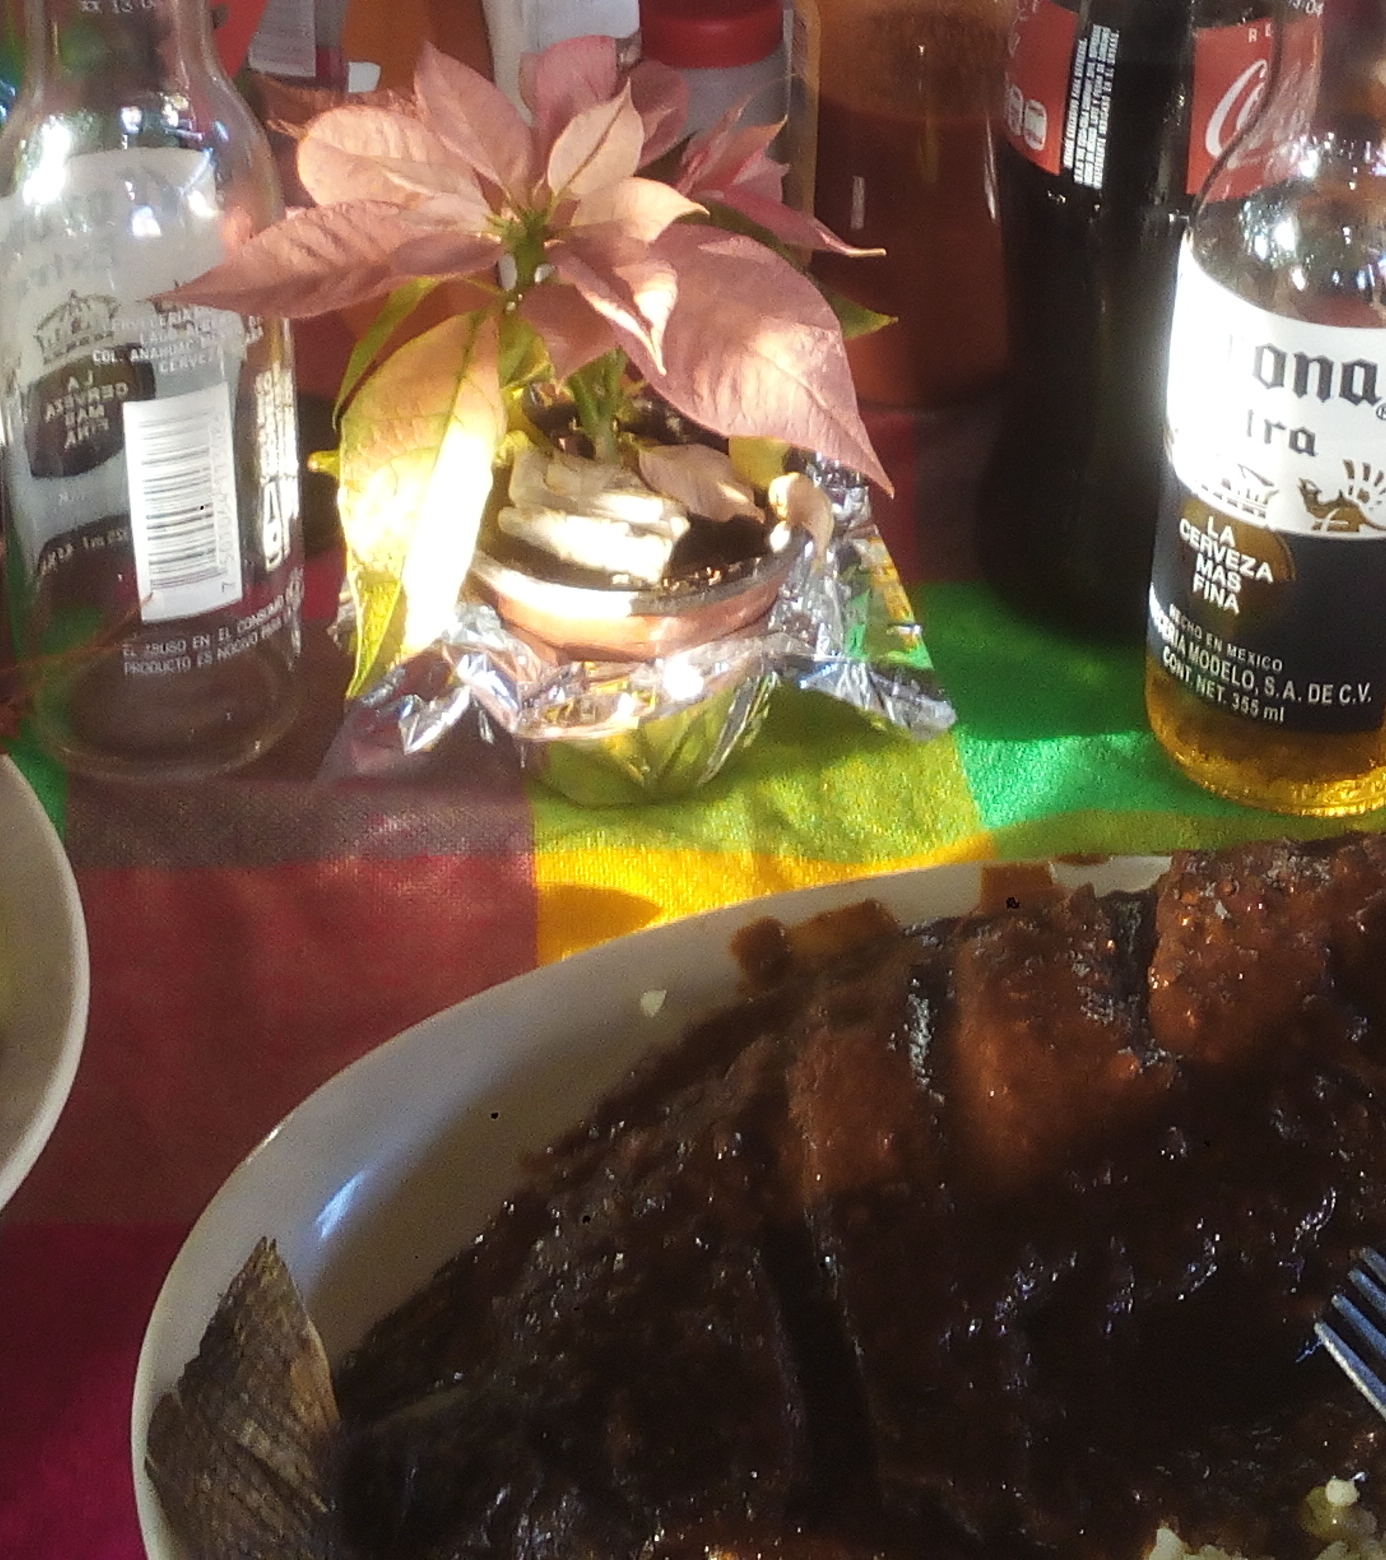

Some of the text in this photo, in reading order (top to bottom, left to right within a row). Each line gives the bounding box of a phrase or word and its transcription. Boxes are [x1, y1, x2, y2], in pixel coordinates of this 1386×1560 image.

[1251, 342, 1382, 407] ona
[1179, 517, 1274, 584] CERVEZA
[1207, 515, 1237, 549] LA
[1192, 572, 1241, 616] FINA
[1196, 551, 1242, 594] MAS
[192, 633, 211, 650] EN
[218, 626, 232, 641] EL
[1169, 603, 1284, 674] HECHO EN MEXICO
[123, 655, 192, 676] PRODUCTO
[1188, 641, 1260, 697] MODELO,
[1308, 682, 1334, 705] DE
[1231, 691, 1260, 718] 355
[1263, 704, 1286, 723] ml
